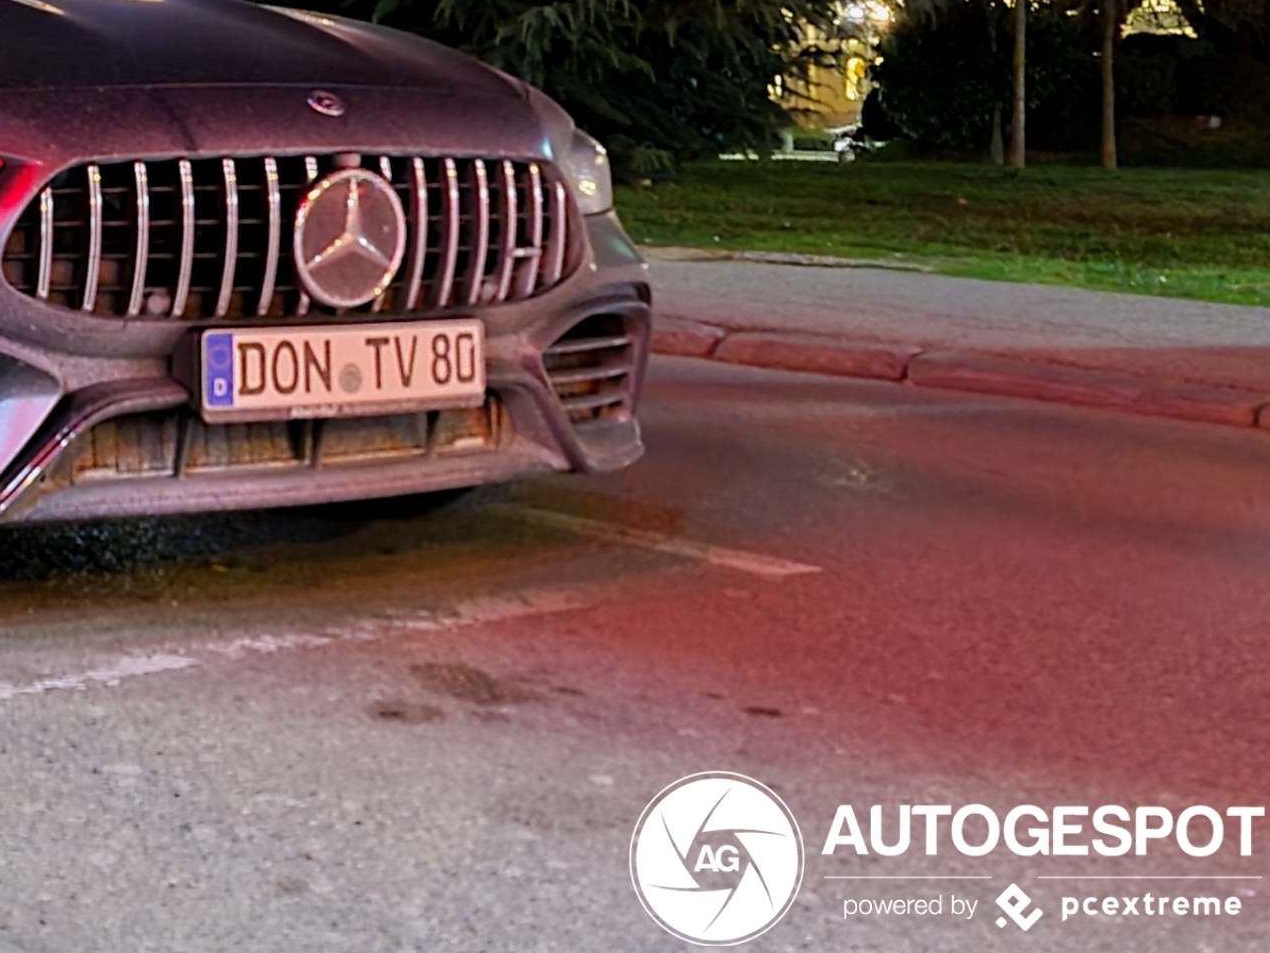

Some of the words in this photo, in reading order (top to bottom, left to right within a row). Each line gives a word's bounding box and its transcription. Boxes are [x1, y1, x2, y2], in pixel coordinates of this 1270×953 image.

[238, 339, 332, 395] DON
[365, 334, 417, 389] TV
[432, 333, 475, 384] 80
[213, 377, 228, 397] D
